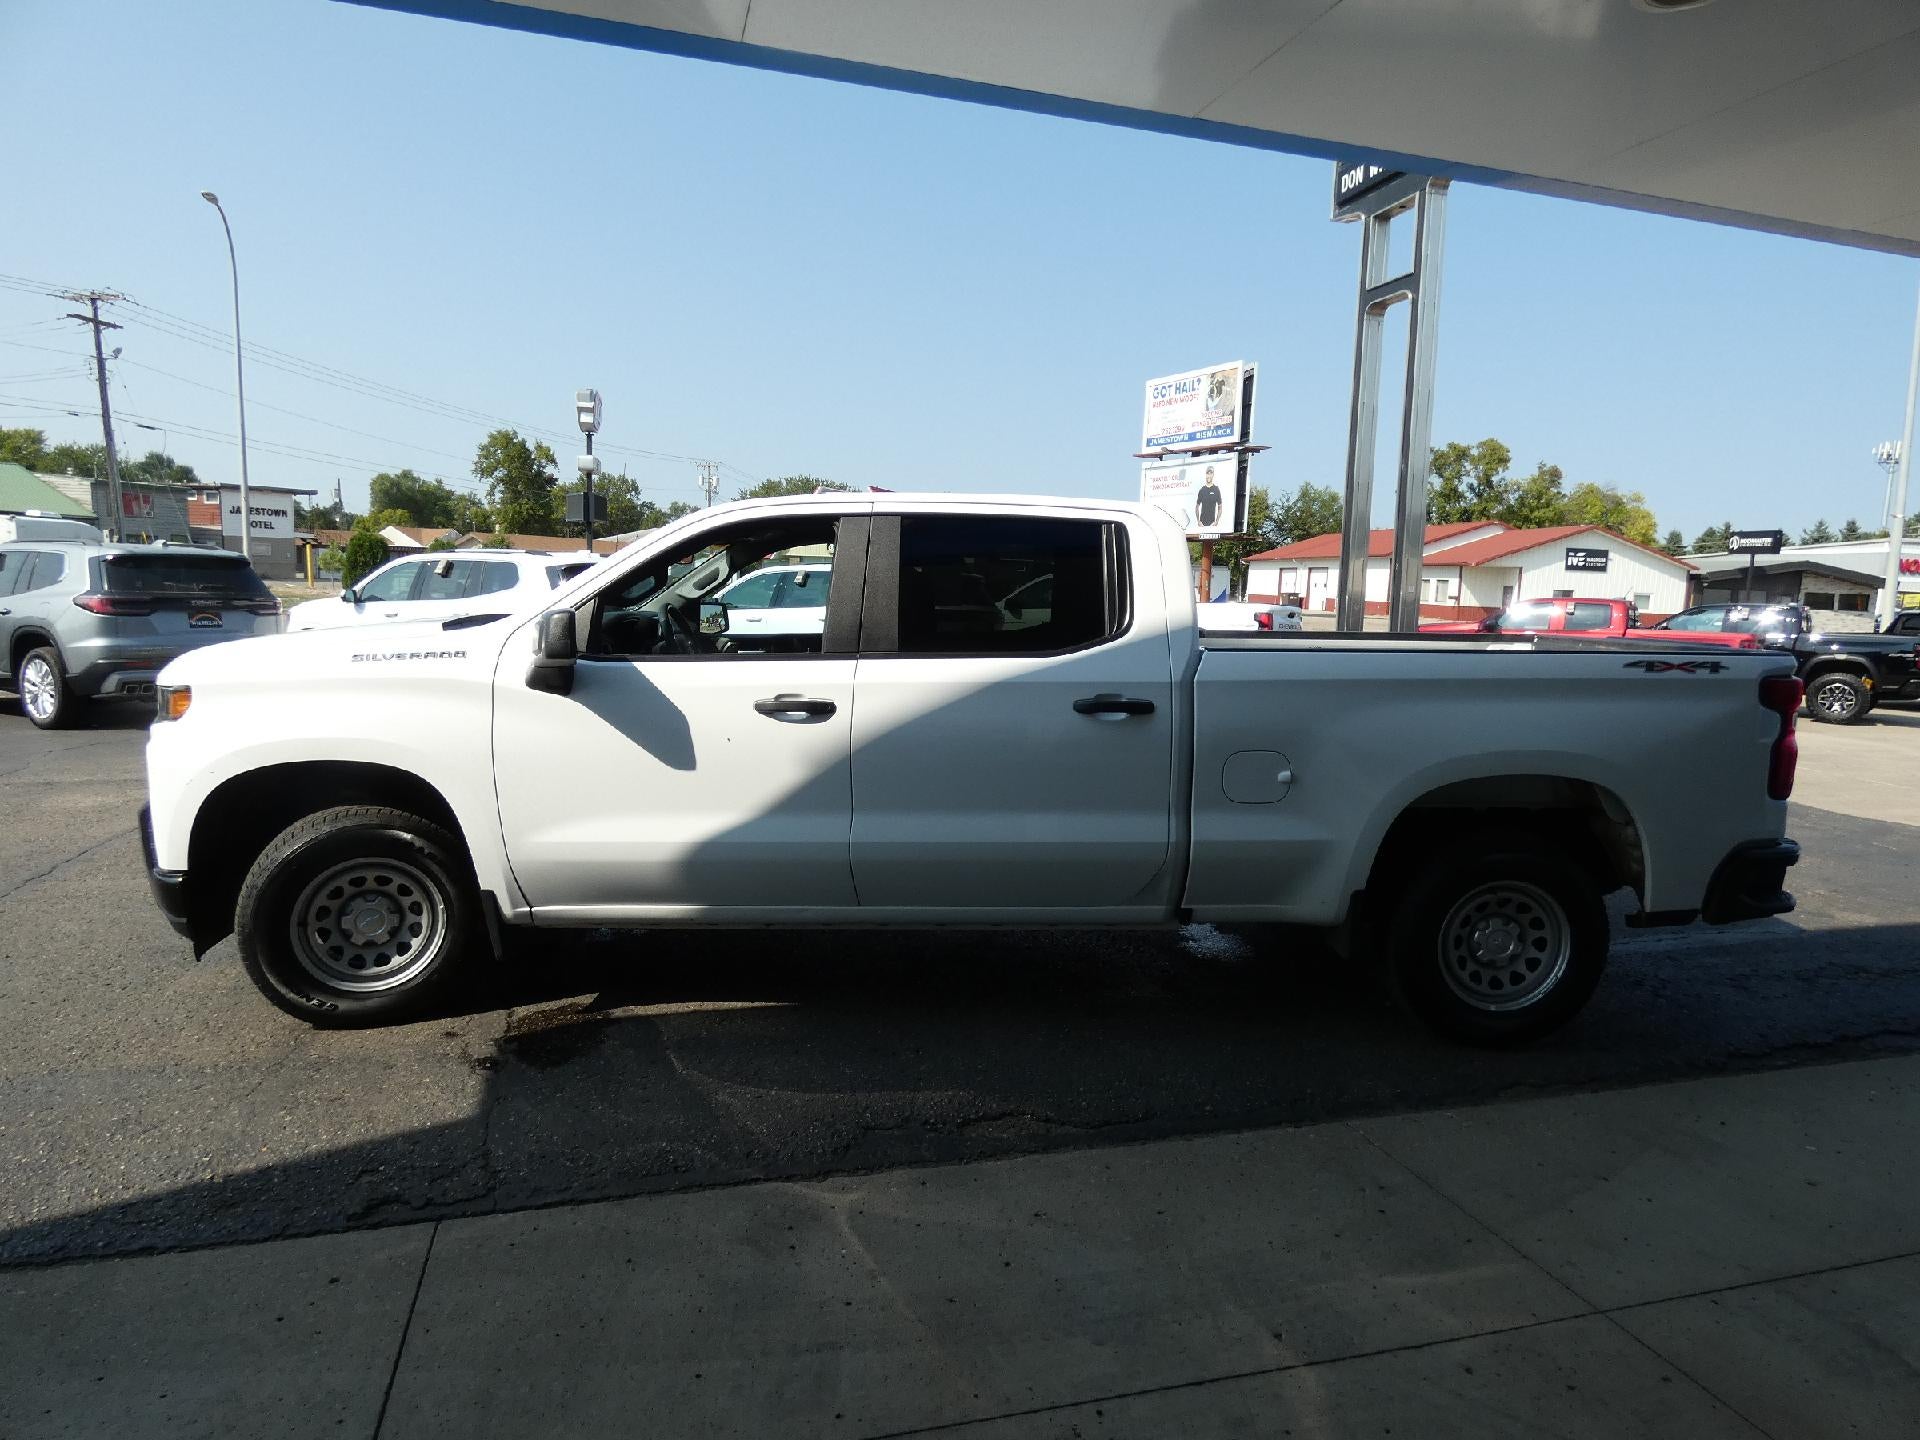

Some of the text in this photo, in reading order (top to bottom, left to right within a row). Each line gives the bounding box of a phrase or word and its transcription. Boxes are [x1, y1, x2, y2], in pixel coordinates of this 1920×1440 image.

[1341, 164, 1365, 193] DON
[1152, 377, 1202, 400] GOT HAIL?
[1150, 433, 1189, 446] JAMESTOWN
[1196, 427, 1232, 440] BISMARCK
[229, 505, 288, 518] JAESTOWN
[249, 520, 275, 530] OTEL
[351, 650, 467, 662] SILVERADO
